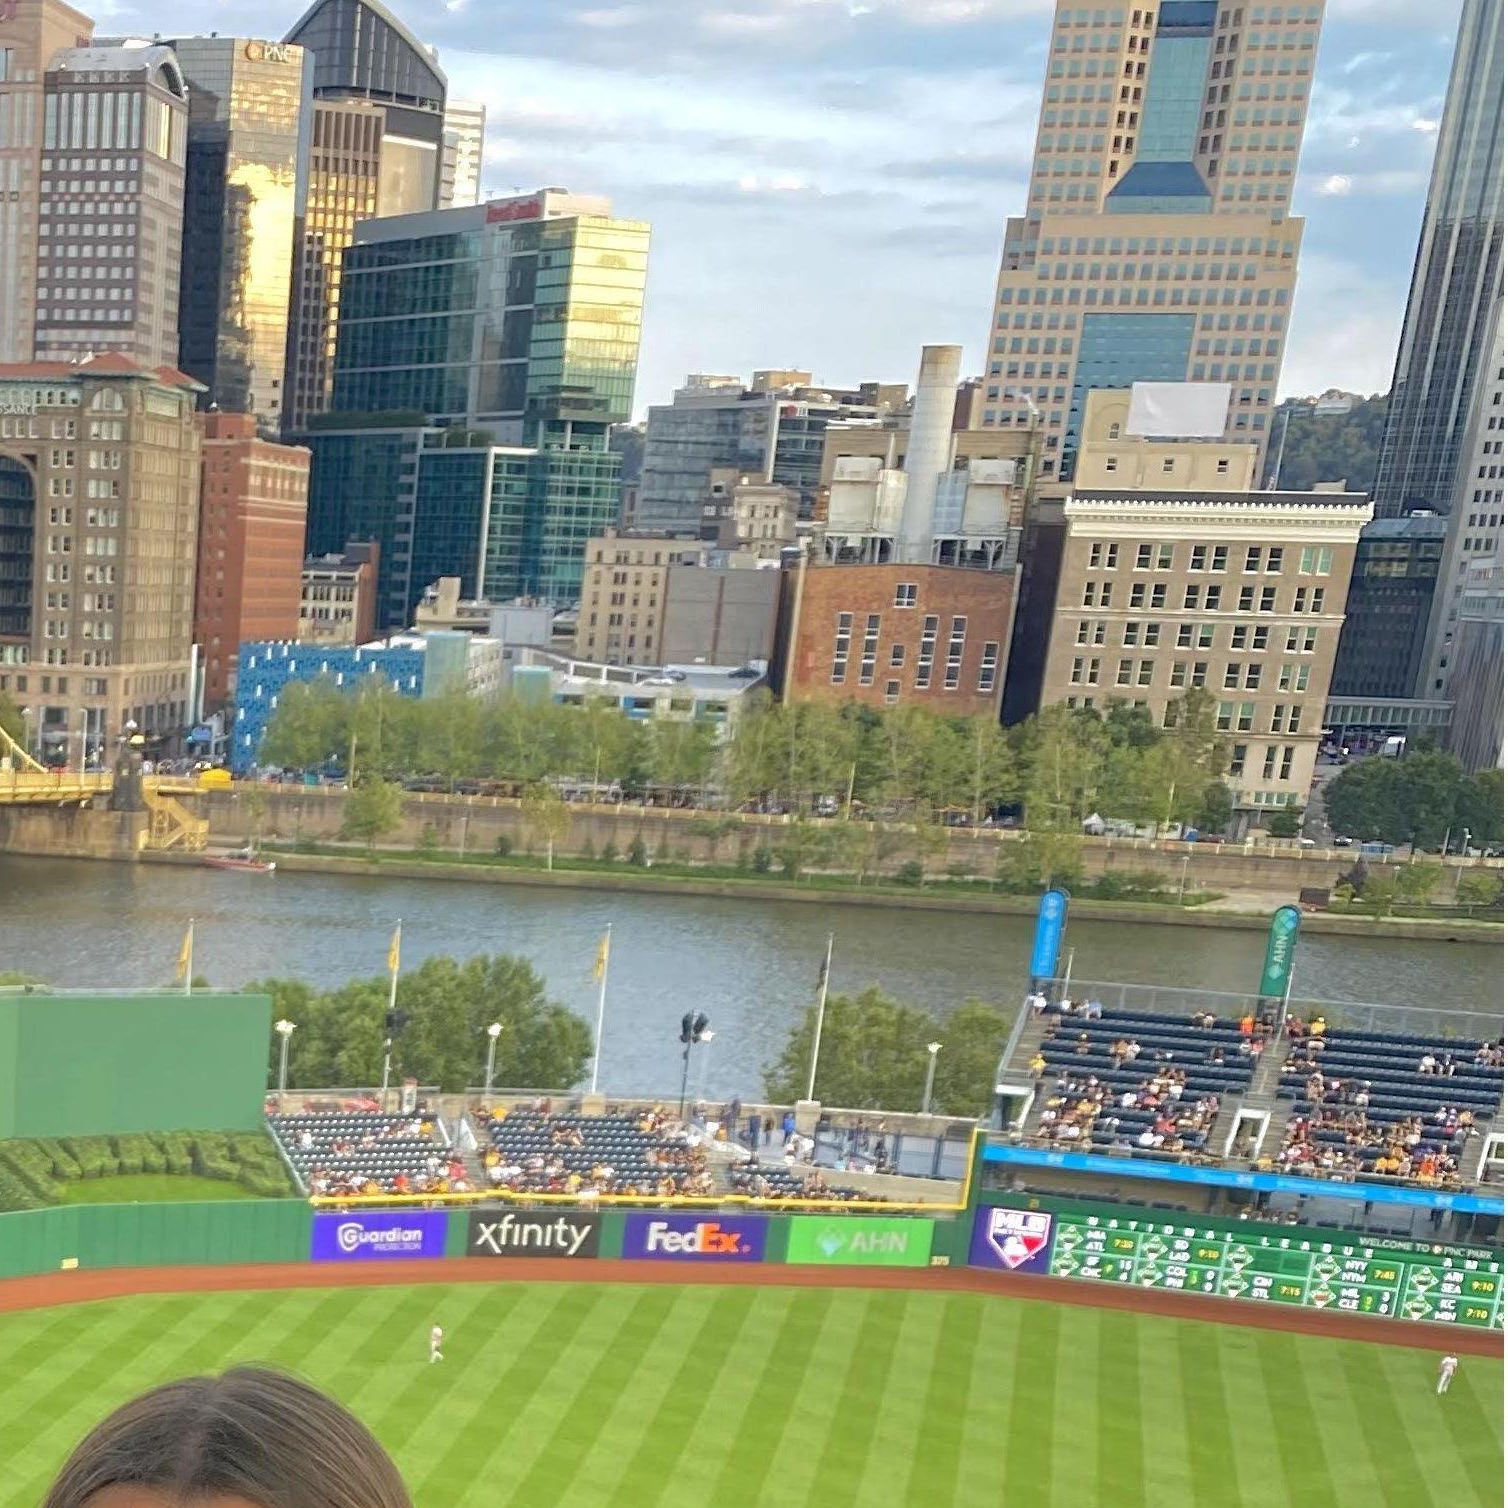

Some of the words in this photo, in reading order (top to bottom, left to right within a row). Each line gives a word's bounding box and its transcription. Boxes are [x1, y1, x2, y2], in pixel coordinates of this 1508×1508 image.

[343, 1226, 422, 1245] Guardian
[476, 1214, 592, 1256] xfinity
[647, 1221, 742, 1253] FedEx
[849, 1230, 908, 1253] AHN
